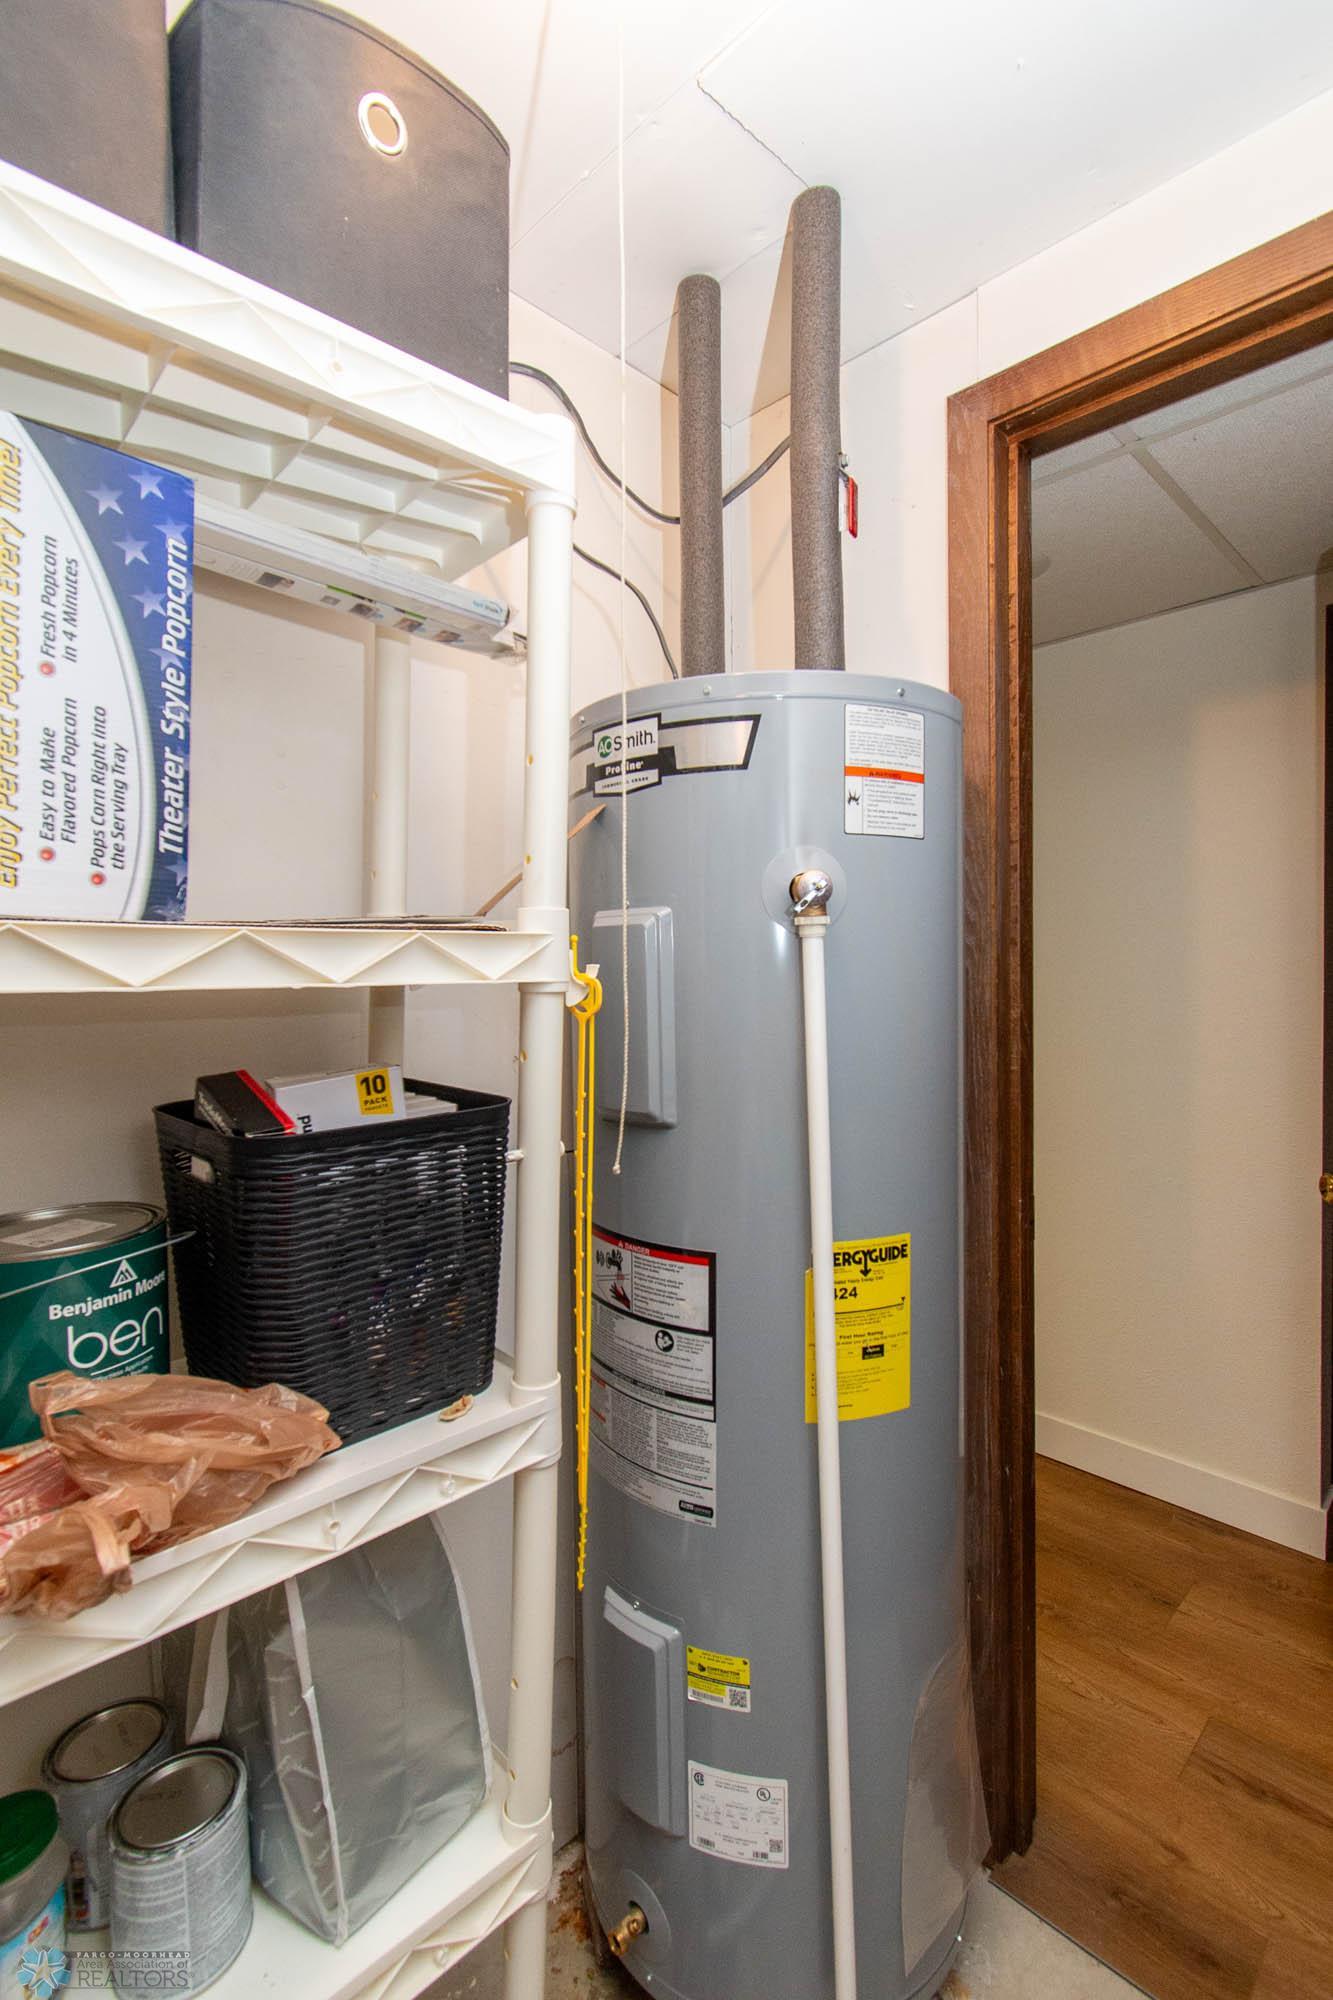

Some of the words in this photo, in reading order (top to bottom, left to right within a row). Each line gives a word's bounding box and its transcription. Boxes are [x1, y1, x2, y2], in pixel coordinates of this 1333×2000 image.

[0, 518, 26, 597] Every
[41, 535, 59, 608] Popcorn
[62, 557, 79, 628] Minutes
[161, 536, 191, 658] Popcorn
[39, 607, 57, 659] Fresh
[63, 630, 77, 645] 4
[0, 601, 24, 711] Popcorn
[61, 647, 77, 663] in
[94, 706, 107, 741] into
[160, 666, 191, 740] Style
[40, 727, 56, 775] Make
[63, 697, 80, 768] Popcorn
[613, 730, 653, 751] Smith
[91, 741, 109, 787] Right
[111, 742, 129, 776] Tray
[605, 761, 643, 776] Proine
[42, 779, 56, 797] to
[61, 771, 77, 844] Flavored
[90, 788, 106, 826] Corn
[159, 746, 185, 854] Theater
[40, 802, 58, 842] Easy
[110, 778, 129, 841] Serving
[91, 827, 107, 869] Pops
[111, 843, 125, 871] the
[360, 1074, 386, 1096] 10
[364, 1096, 387, 1106] PACK
[624, 1242, 650, 1256] DANGER
[833, 1243, 908, 1272] ERGYGUIDE
[48, 1288, 133, 1321] Benjamin
[67, 1306, 164, 1369] ben
